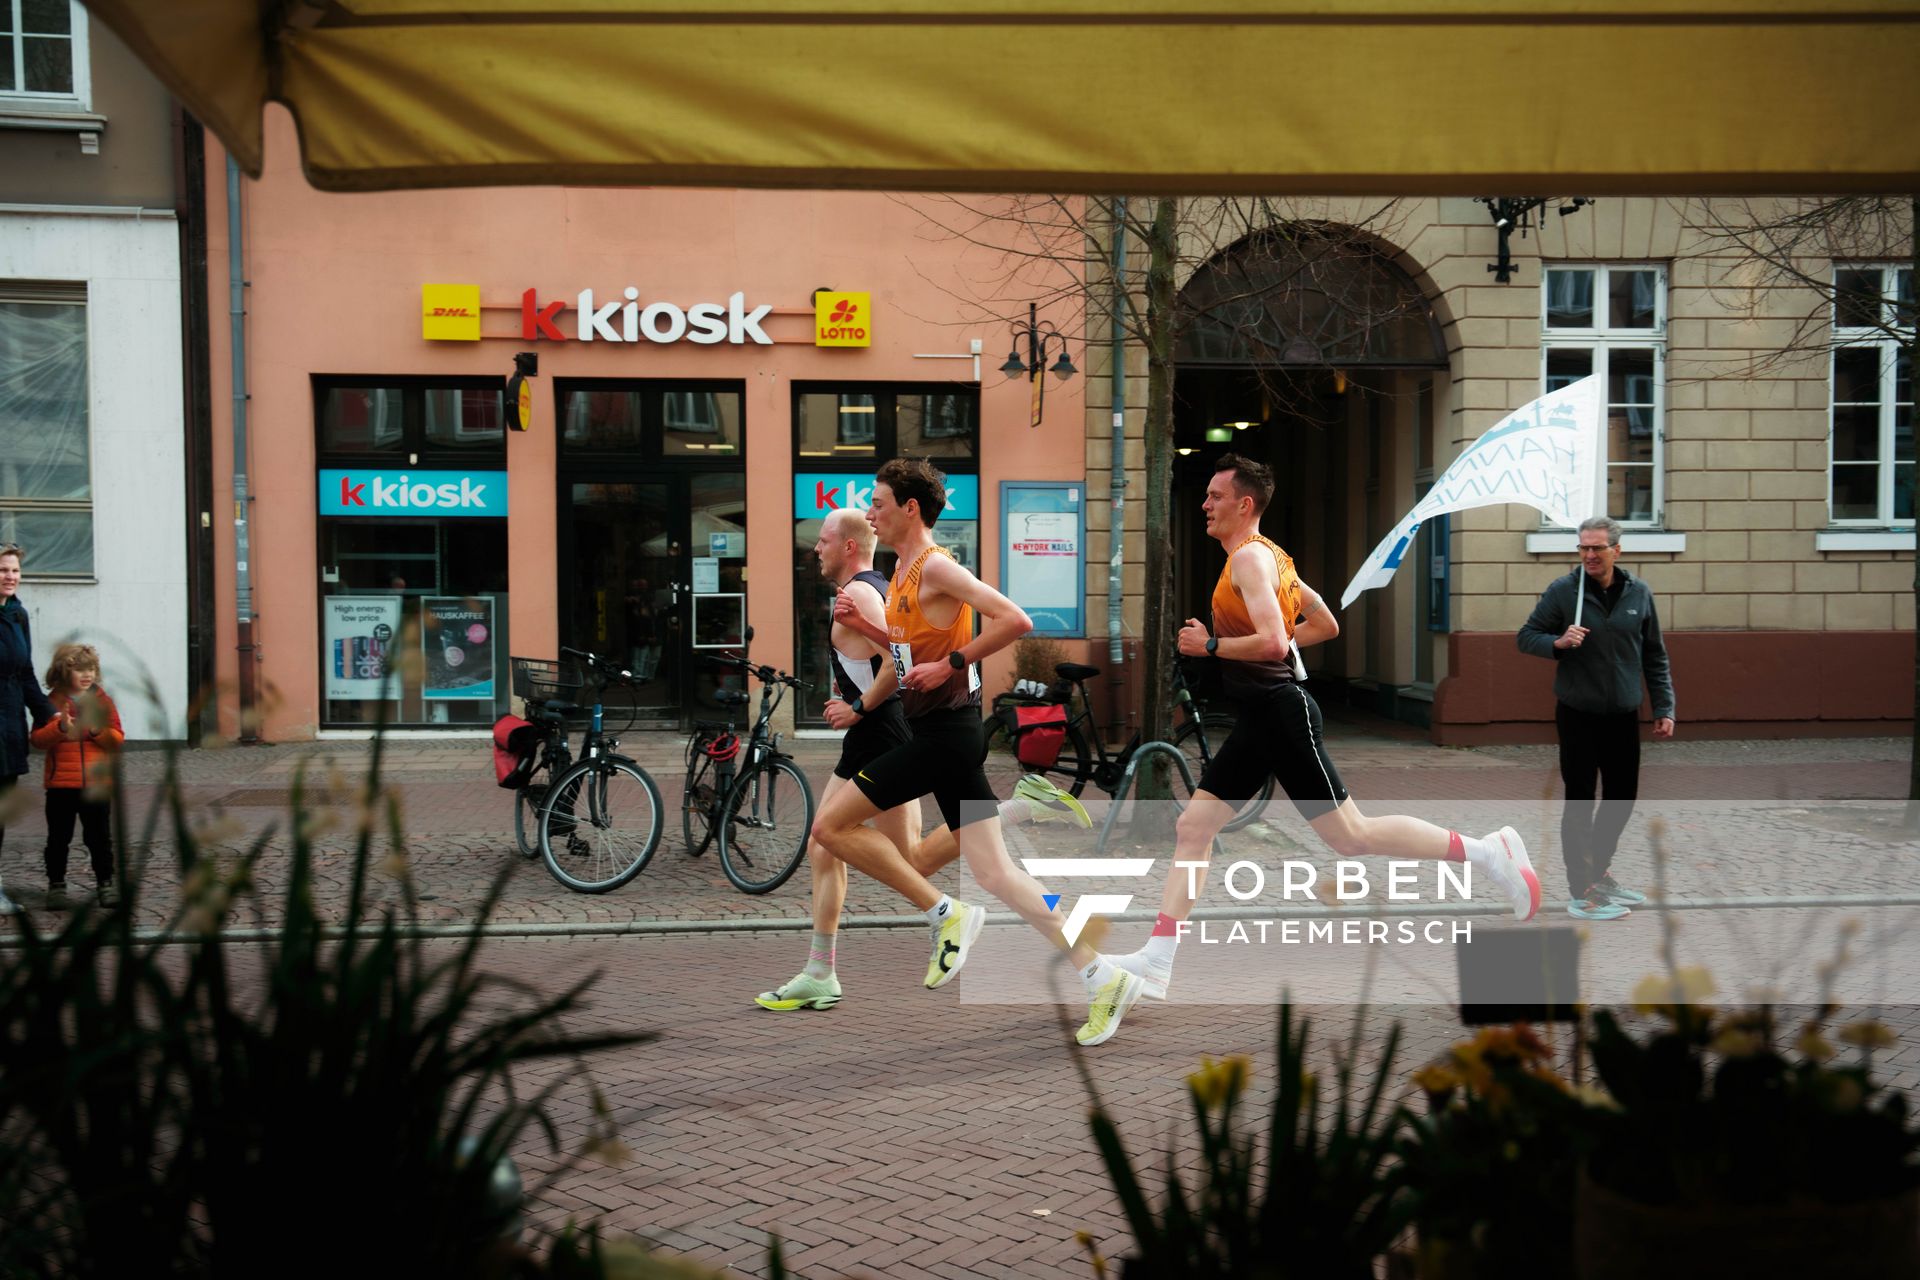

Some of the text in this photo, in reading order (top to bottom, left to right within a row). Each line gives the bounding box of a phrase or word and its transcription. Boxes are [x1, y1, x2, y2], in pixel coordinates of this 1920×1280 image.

[432, 308, 469, 317] DHL
[522, 286, 774, 345] k kiosk
[820, 326, 866, 340] LOTTO
[341, 475, 487, 507] k kiosk
[1051, 543, 1074, 552] NAILS
[334, 605, 354, 614] High
[341, 614, 380, 623] low price
